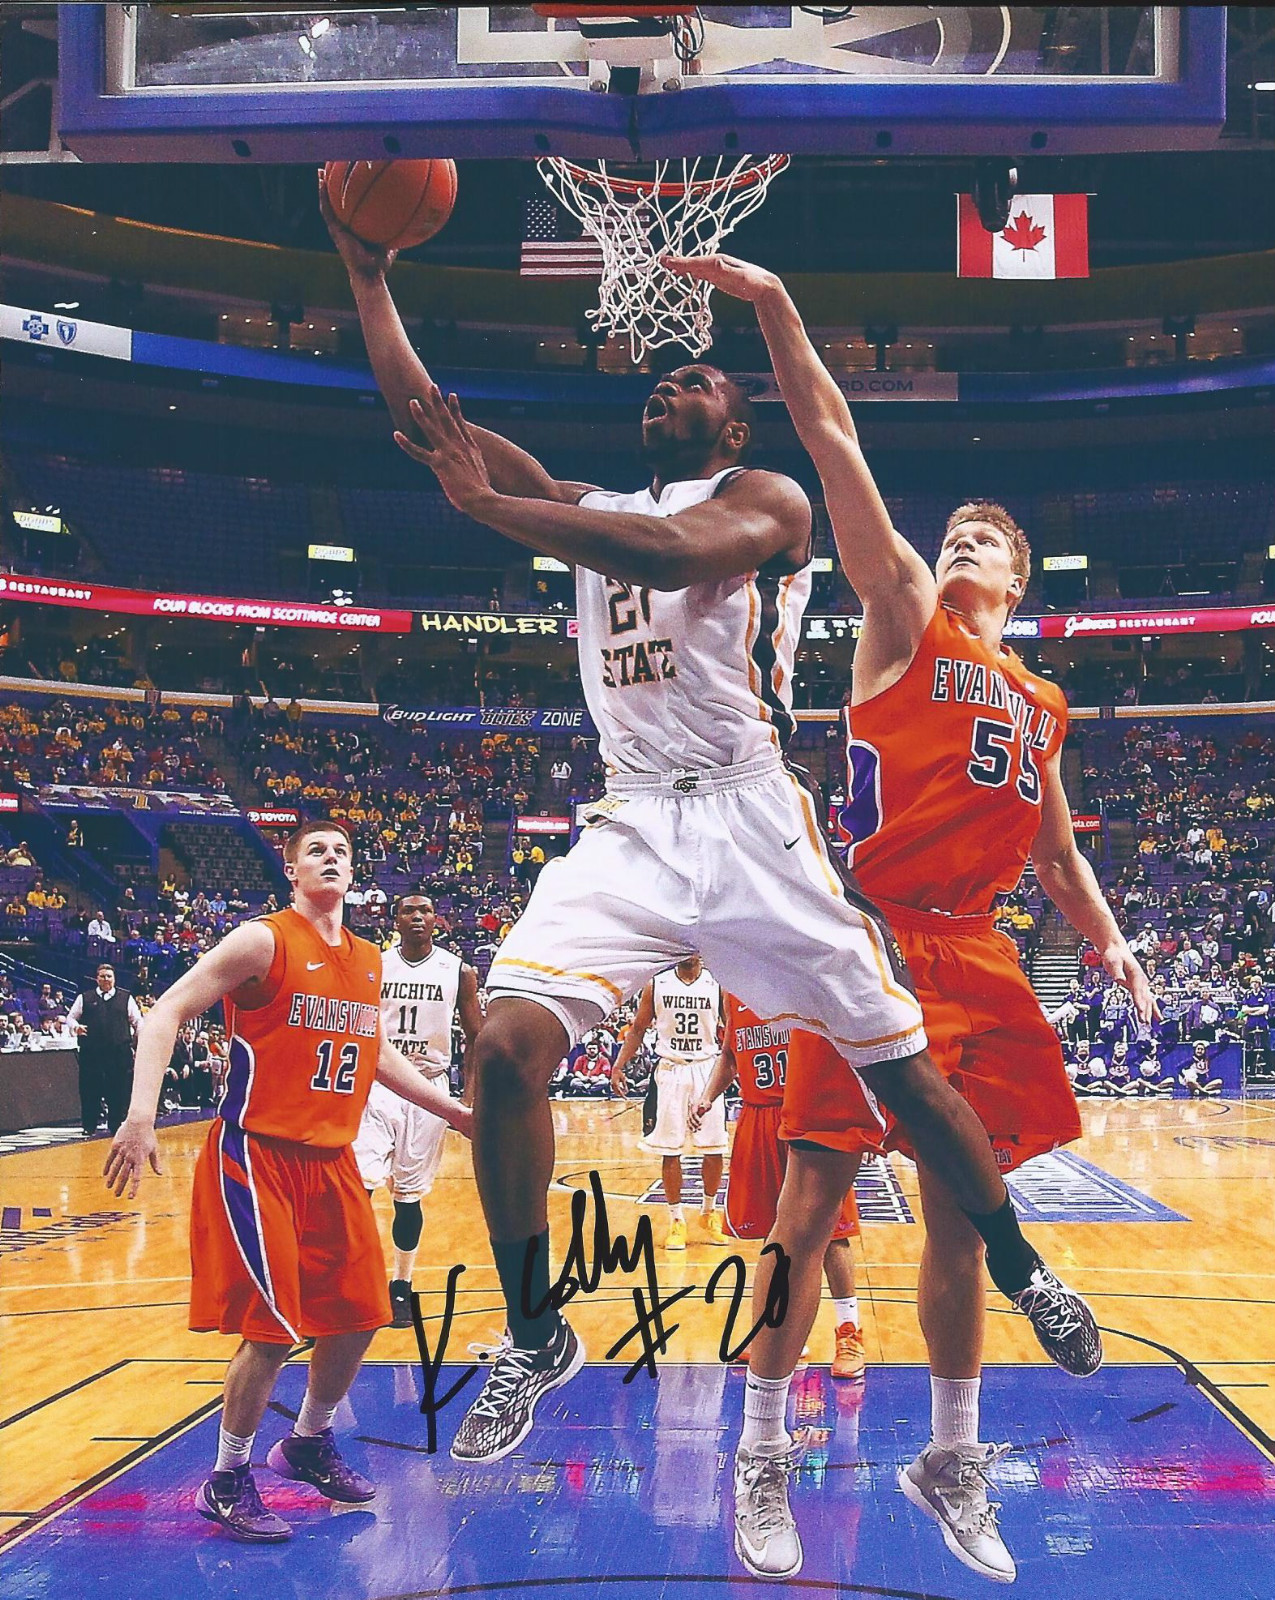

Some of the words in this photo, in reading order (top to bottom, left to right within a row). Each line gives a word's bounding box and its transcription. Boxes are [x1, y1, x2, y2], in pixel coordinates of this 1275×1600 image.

[9, 581, 92, 600] RESTAURANT
[153, 598, 187, 613] FOUR
[187, 601, 235, 617] BLOCKS
[236, 605, 271, 620] FROM
[272, 608, 337, 624] SCOTTRADE
[339, 612, 381, 627] CENTER
[1119, 616, 1196, 628] RESTAURANT
[421, 613, 558, 635] HANDLER
[541, 711, 583, 727] ZONE
[967, 716, 1042, 805] 55
[260, 812, 297, 822] TOYOTA
[381, 982, 444, 1002] WICHITA
[662, 995, 712, 1010] WICHITA
[397, 1005, 418, 1035] 11
[674, 1013, 699, 1035] 32
[387, 1038, 429, 1056] TATE
[670, 1038, 703, 1051] STATE
[310, 1040, 360, 1094] 12
[753, 1050, 789, 1089] 31
